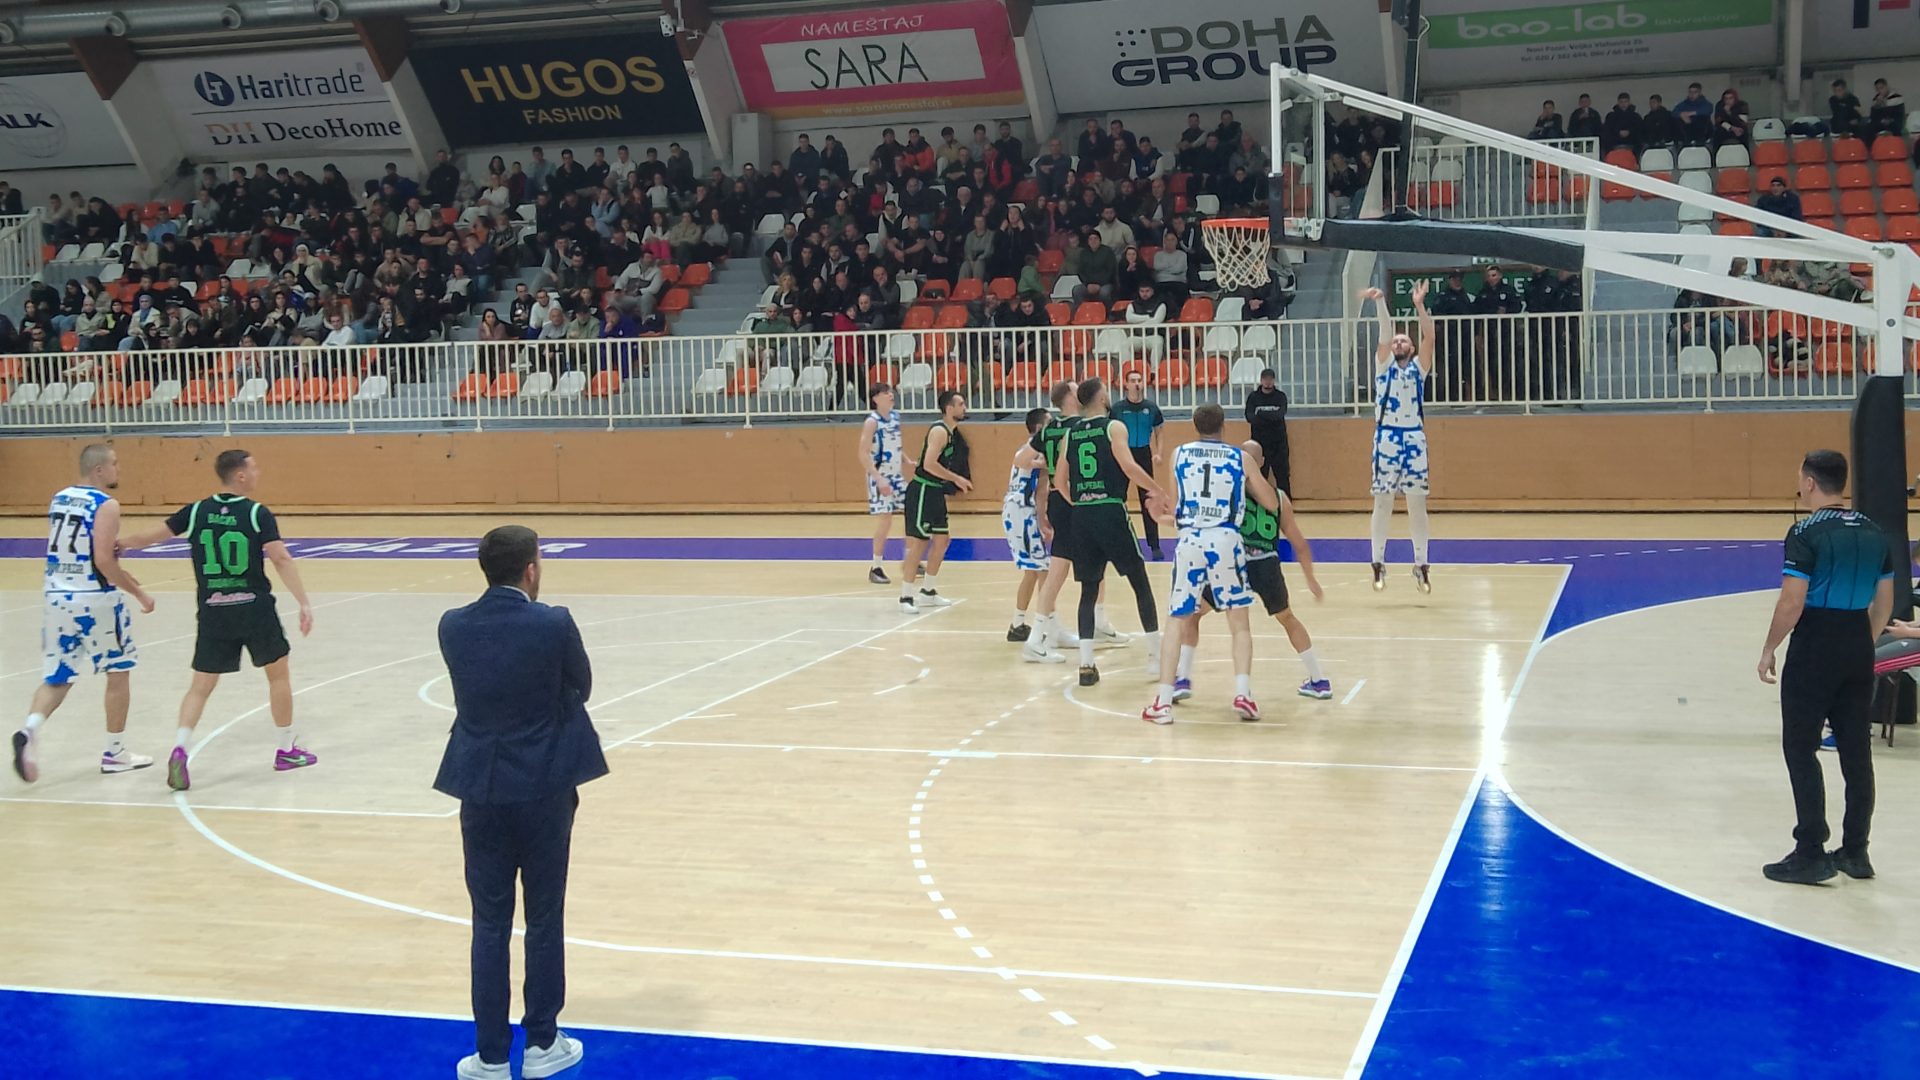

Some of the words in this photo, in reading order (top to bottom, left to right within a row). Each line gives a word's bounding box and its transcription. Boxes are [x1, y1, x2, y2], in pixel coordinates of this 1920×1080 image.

[801, 14, 925, 37] NAMEŠTAJ
[1150, 14, 1335, 54] DOHA
[1457, 4, 1648, 39] beo-lab
[461, 56, 665, 103] HUGOS
[804, 42, 929, 89] SARA
[1112, 44, 1337, 87] GROUP
[237, 68, 365, 100] Haritrade
[262, 118, 402, 142] DecoHome
[523, 105, 623, 125] FASHION
[1078, 442, 1098, 478] 6
[1200, 463, 1211, 498] 1
[48, 512, 86, 554] 77
[199, 529, 250, 575] 10
